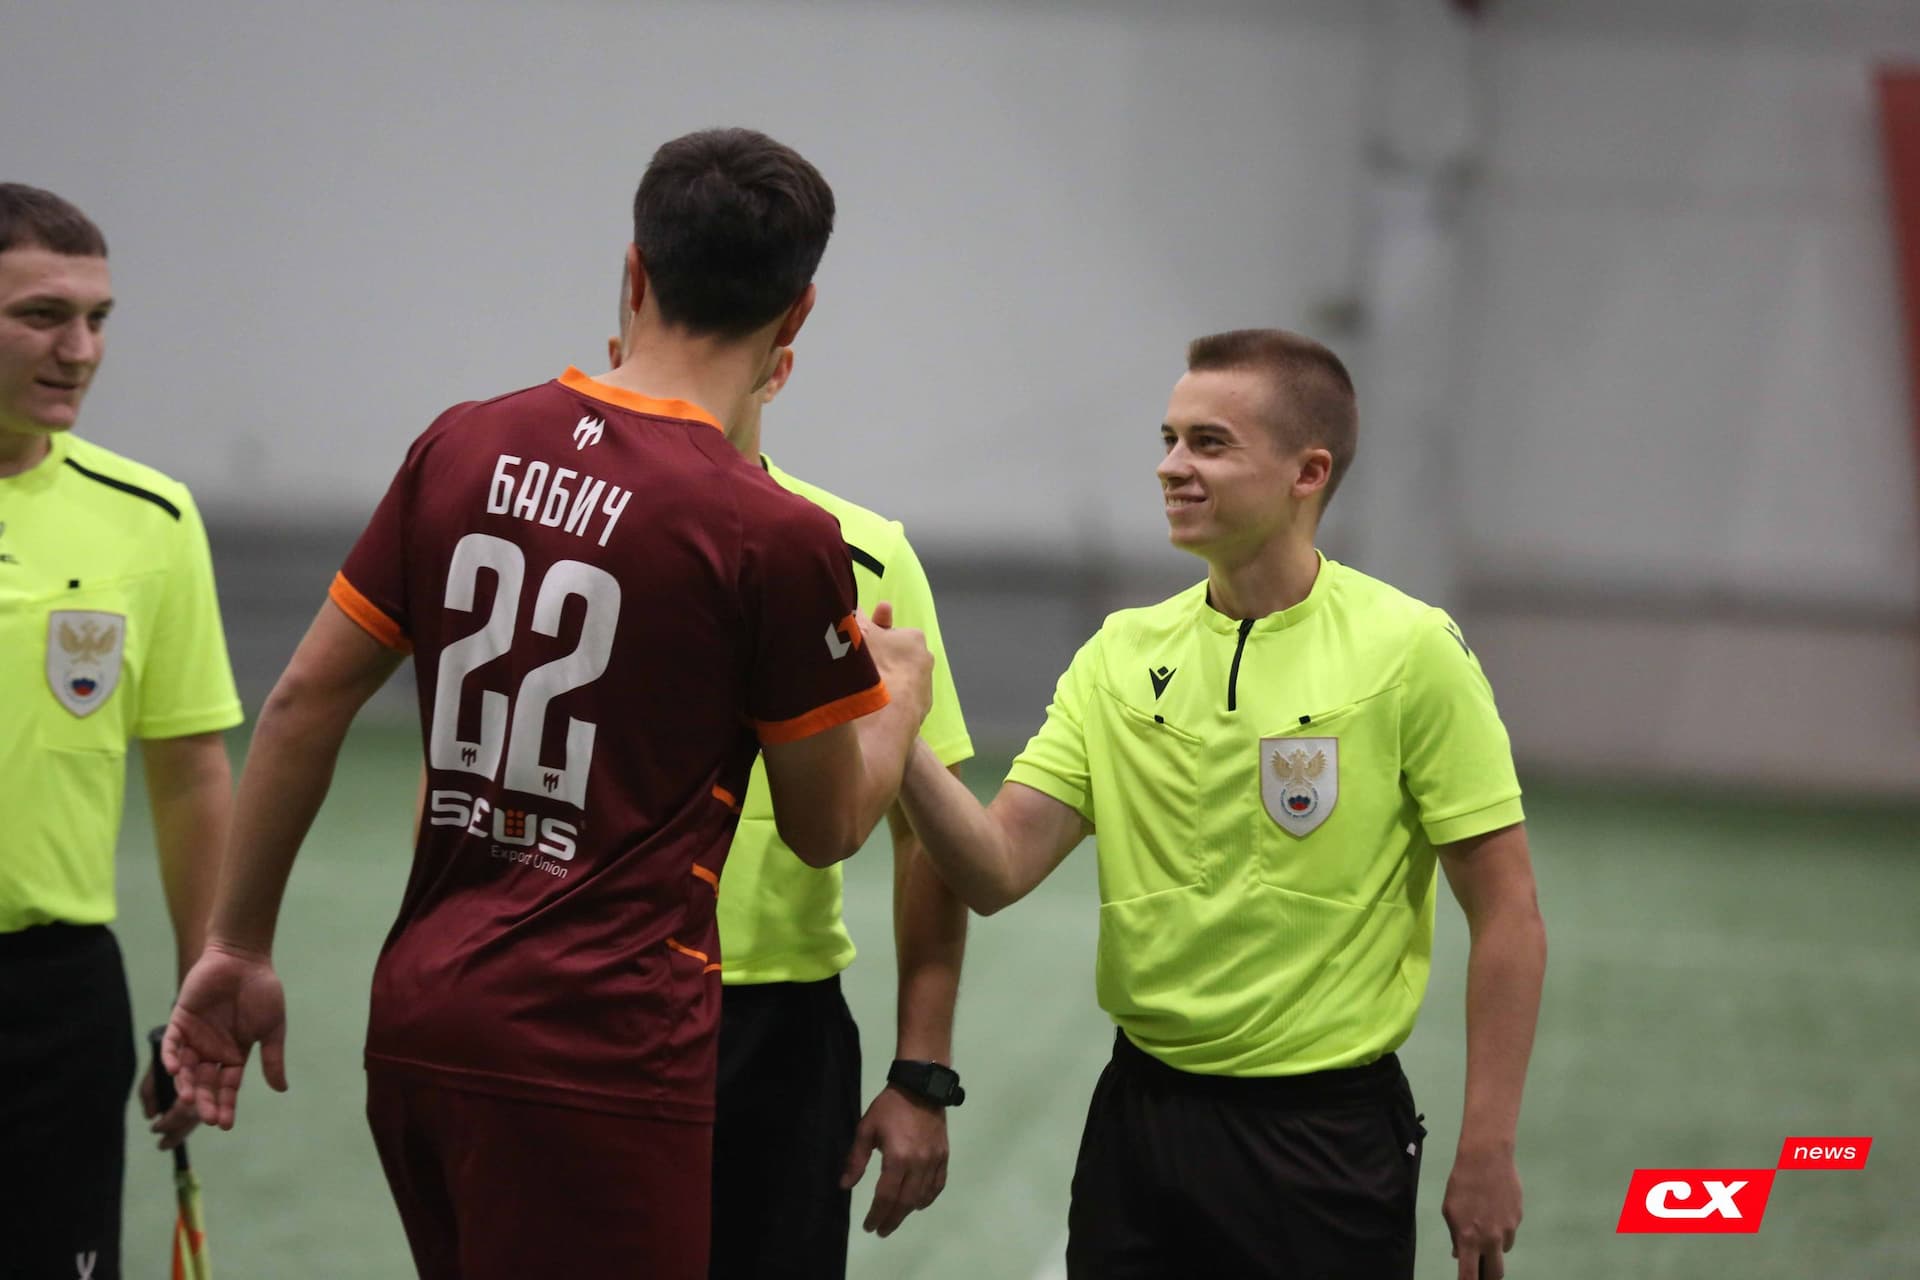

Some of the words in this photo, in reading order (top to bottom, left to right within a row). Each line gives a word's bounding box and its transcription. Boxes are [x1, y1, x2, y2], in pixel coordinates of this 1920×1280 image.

[487, 455, 632, 546] БАБИЧ
[430, 533, 622, 811] 22
[431, 790, 578, 861] SEUS
[491, 845, 532, 866] Export
[533, 853, 568, 879] Union
